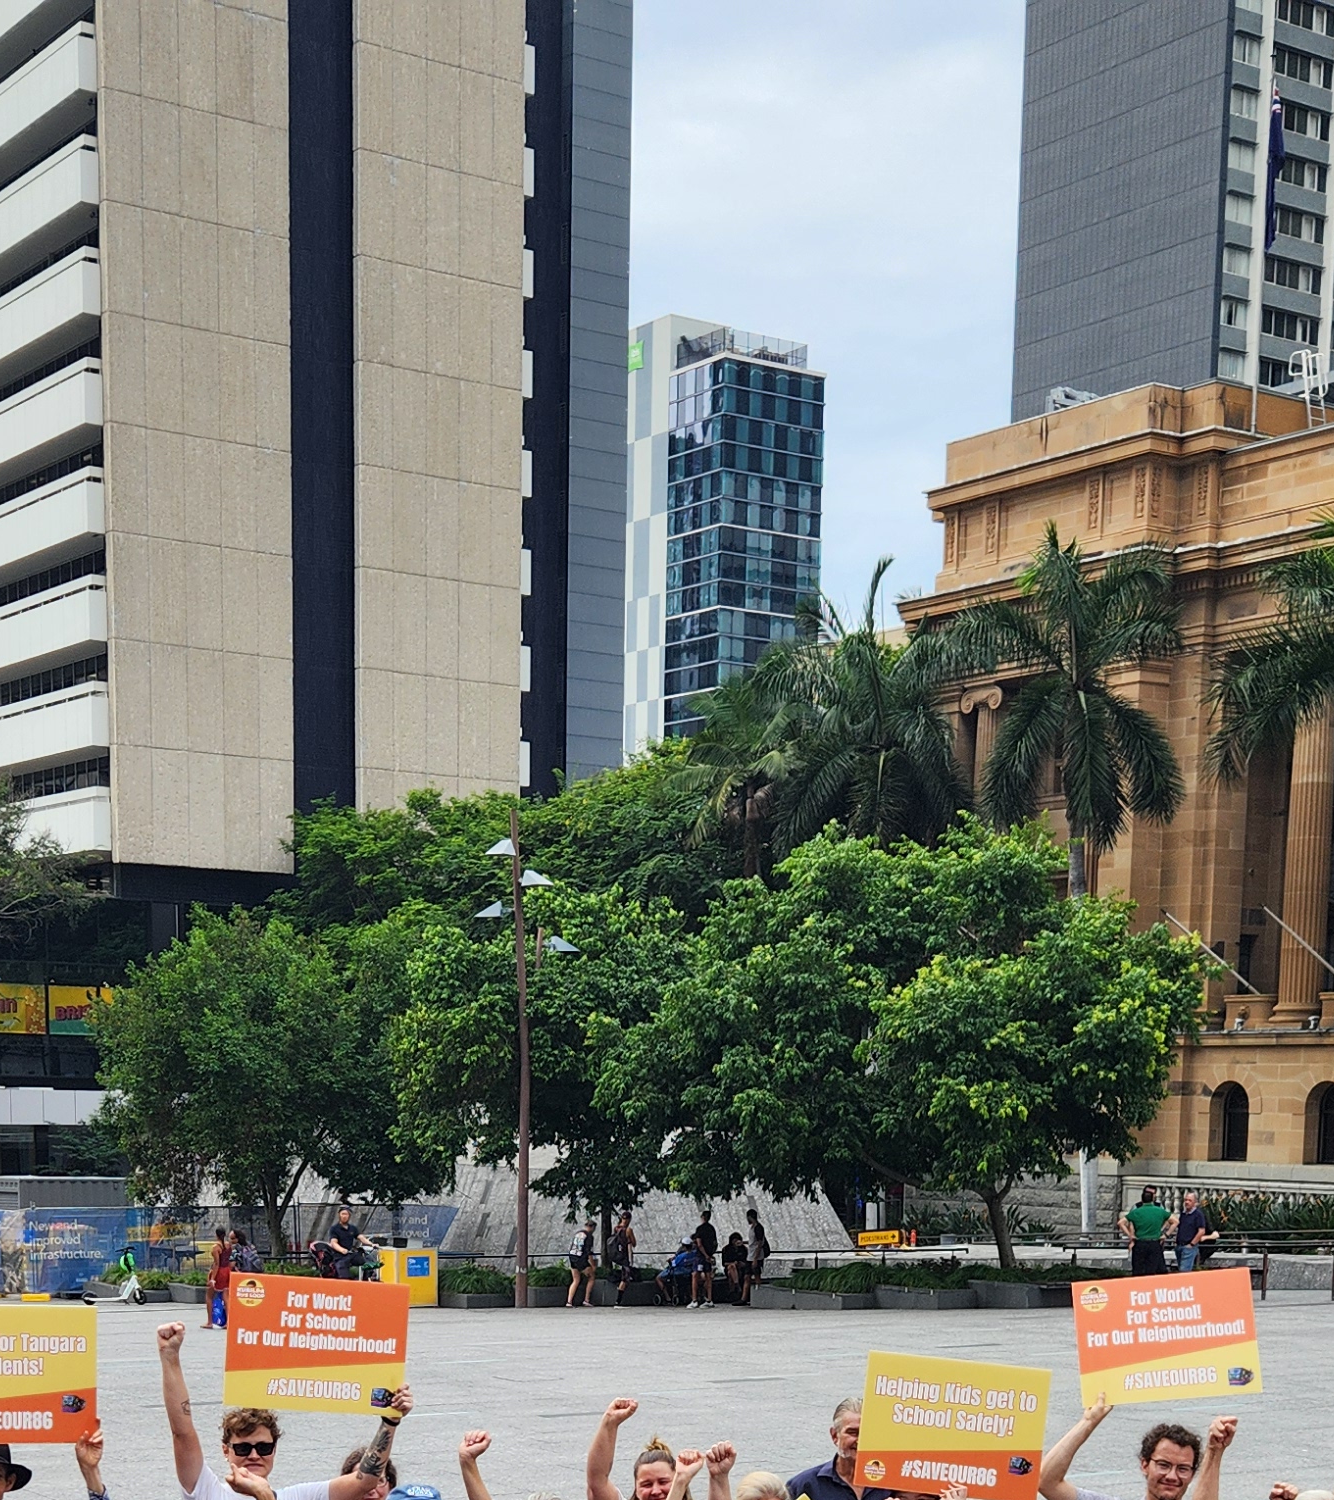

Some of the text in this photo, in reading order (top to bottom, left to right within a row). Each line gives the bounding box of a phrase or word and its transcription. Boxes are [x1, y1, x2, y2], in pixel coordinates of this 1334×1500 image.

[30, 1233, 81, 1249] improved
[30, 1250, 104, 1260] infrastructure.
[287, 1291, 352, 1312] For Work!
[1129, 1285, 1195, 1307] For Work!
[280, 1310, 356, 1332] For School!
[1125, 1303, 1202, 1326] For School!
[20, 1333, 87, 1355] Tangara
[237, 1328, 397, 1355] For Our Neighbourhood!
[1086, 1318, 1246, 1348] For Our Neighbourhood!
[266, 1377, 361, 1401] #SAVEOUR86
[1124, 1366, 1218, 1391] #SAVEOUR86
[875, 1375, 1038, 1414] Helping Kids get to
[892, 1403, 1015, 1438] School Safely!
[900, 1460, 998, 1487] #SAVEOUR86
